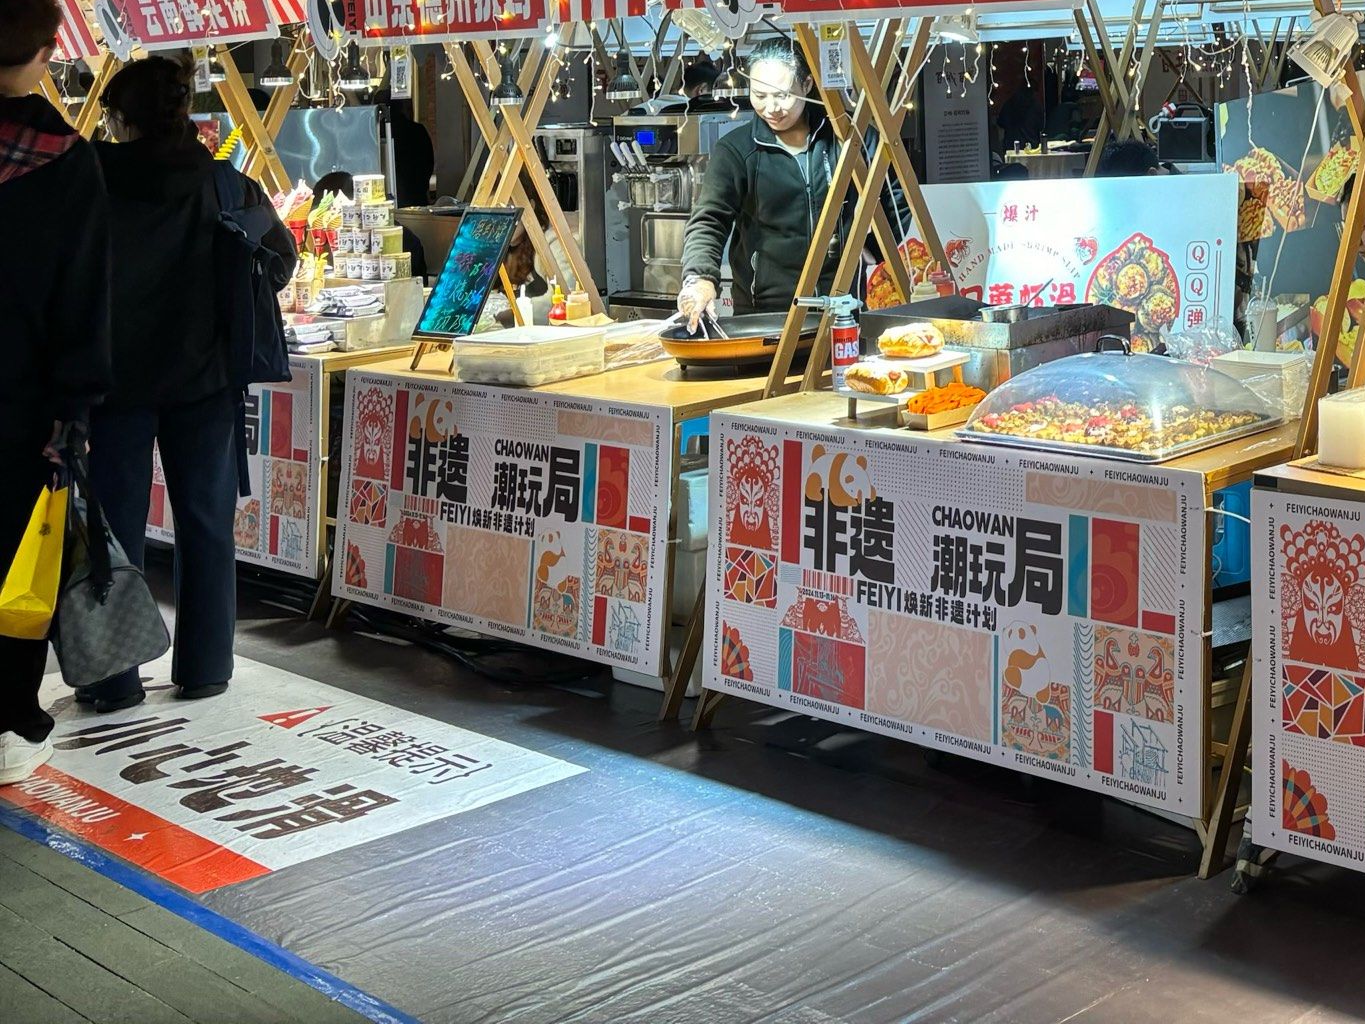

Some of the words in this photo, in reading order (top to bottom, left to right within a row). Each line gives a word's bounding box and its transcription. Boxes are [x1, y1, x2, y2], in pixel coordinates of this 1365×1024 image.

[405, 428, 470, 505] 非遗
[494, 438, 550, 463] CHAOWAN
[731, 422, 778, 436] FEIYICHAOWANJU
[796, 430, 846, 445] FEIYICHAOWANJU
[865, 439, 918, 455] FEIYICHAOWANJU
[939, 448, 996, 465] FEIYICHAOWANJU
[1018, 458, 1079, 475] FEIYICHAOWANJU
[1104, 469, 1169, 487] FEIYICHAOWANJU
[440, 501, 471, 525] FEIYI
[931, 505, 1014, 538] CHAOWAN
[1286, 502, 1361, 522] FEIYICHAOWANJU
[803, 488, 895, 585] 非遗
[930, 517, 1064, 616] 潮玩局
[856, 580, 902, 612] FEIYI
[903, 590, 997, 632] 焕新非遗计划
[1268, 625, 1276, 709] FEIYICHAOWANJU
[724, 677, 771, 697] FEIYICHAOWANJU
[789, 694, 840, 715] FEIYICHAOWANJU
[859, 713, 913, 734] FEIYICHAOWANJU
[934, 732, 992, 756] FEIYICHAOWANJU
[1015, 753, 1076, 777] FEIYICHAOWANJU
[1101, 775, 1167, 801] FEIYICHAOWANJU
[12, 775, 121, 823] AOWANJU
[52, 715, 400, 840] 小心地滑
[1268, 734, 1276, 818] FEIYICHAOWANJU
[1288, 833, 1365, 863] FEIYICHAOWANJU
